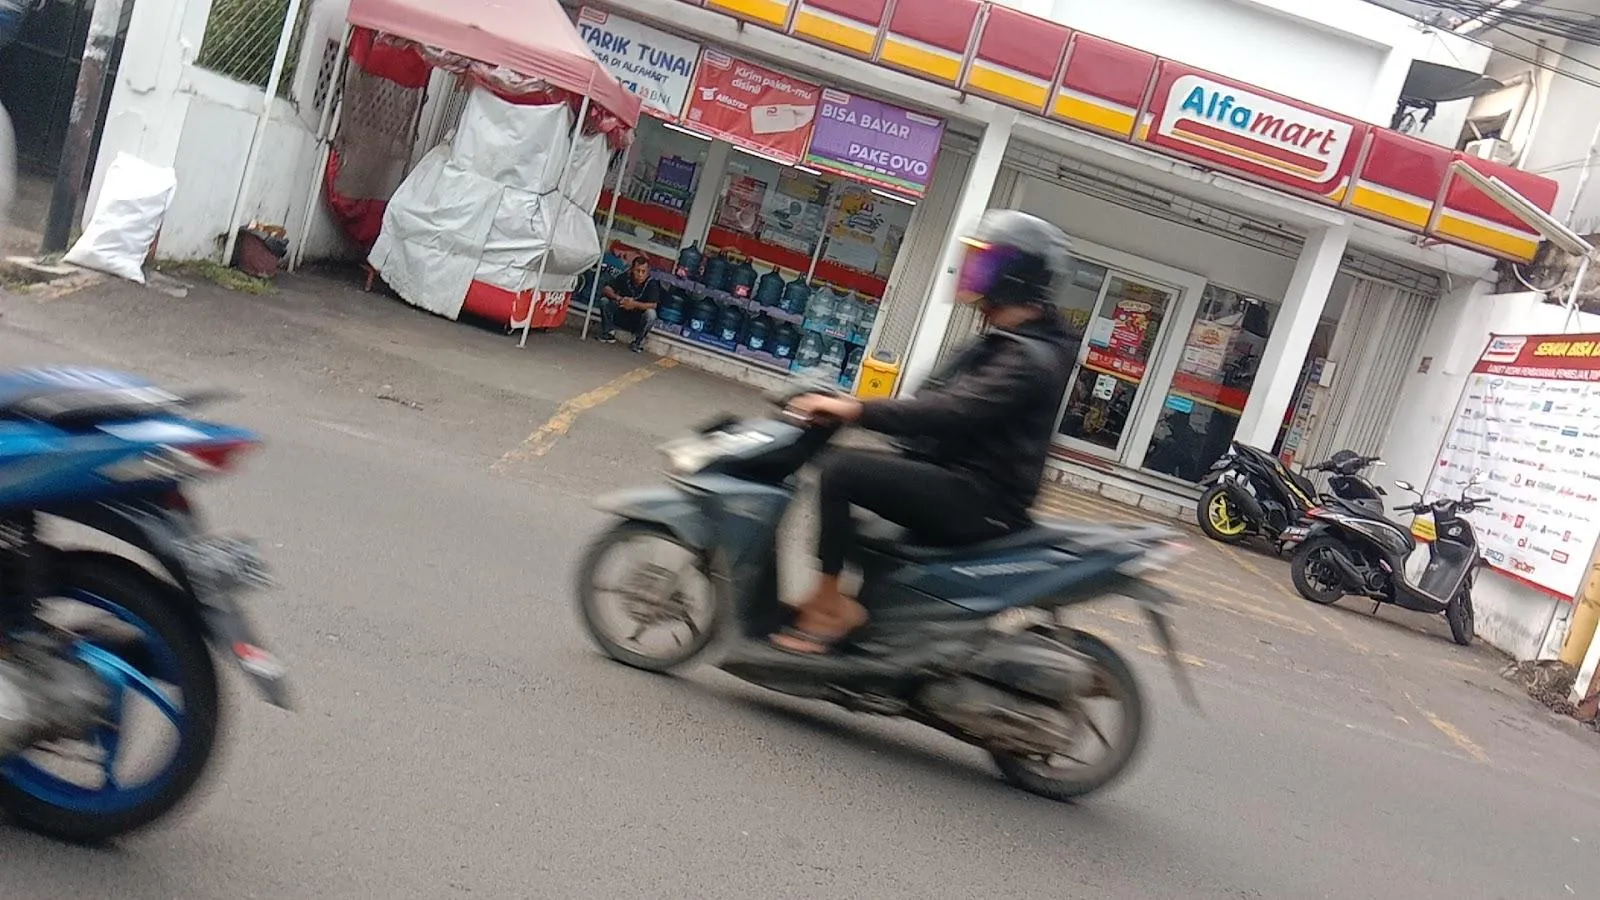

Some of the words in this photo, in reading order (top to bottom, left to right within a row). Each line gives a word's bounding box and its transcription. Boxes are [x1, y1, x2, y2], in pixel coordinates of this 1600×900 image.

[580, 23, 631, 55] TARIK
[638, 42, 692, 77] TUNAI
[611, 58, 621, 68] DI
[735, 66, 762, 83] Kirim
[649, 89, 672, 104] BNI
[822, 103, 856, 125] BISA
[860, 114, 910, 139] BAYAR
[1181, 86, 1337, 155] Alfamart
[848, 143, 889, 166] PAKE
[889, 155, 928, 176] OVO
